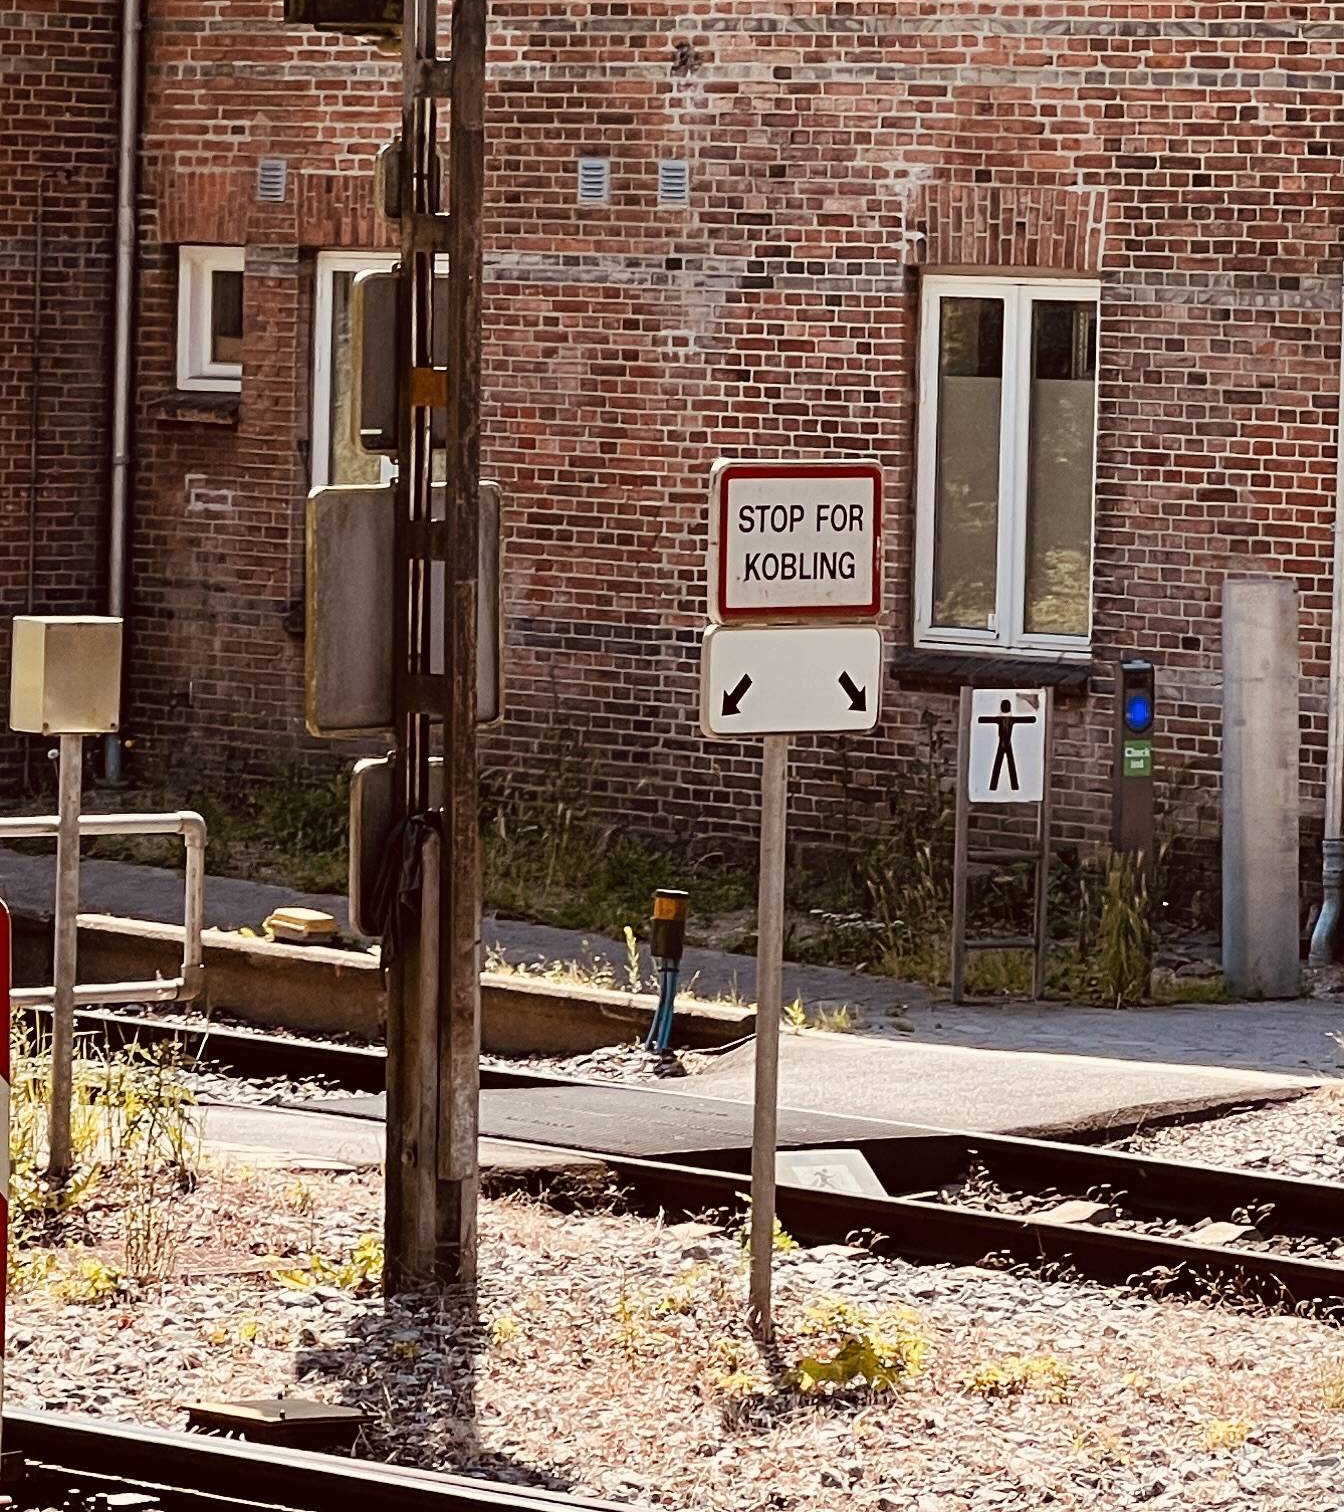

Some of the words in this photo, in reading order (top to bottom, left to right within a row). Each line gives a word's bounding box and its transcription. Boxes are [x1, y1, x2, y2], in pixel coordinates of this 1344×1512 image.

[738, 504, 805, 533] STOP
[816, 504, 864, 532] FOR
[743, 551, 856, 582] KOBLING
